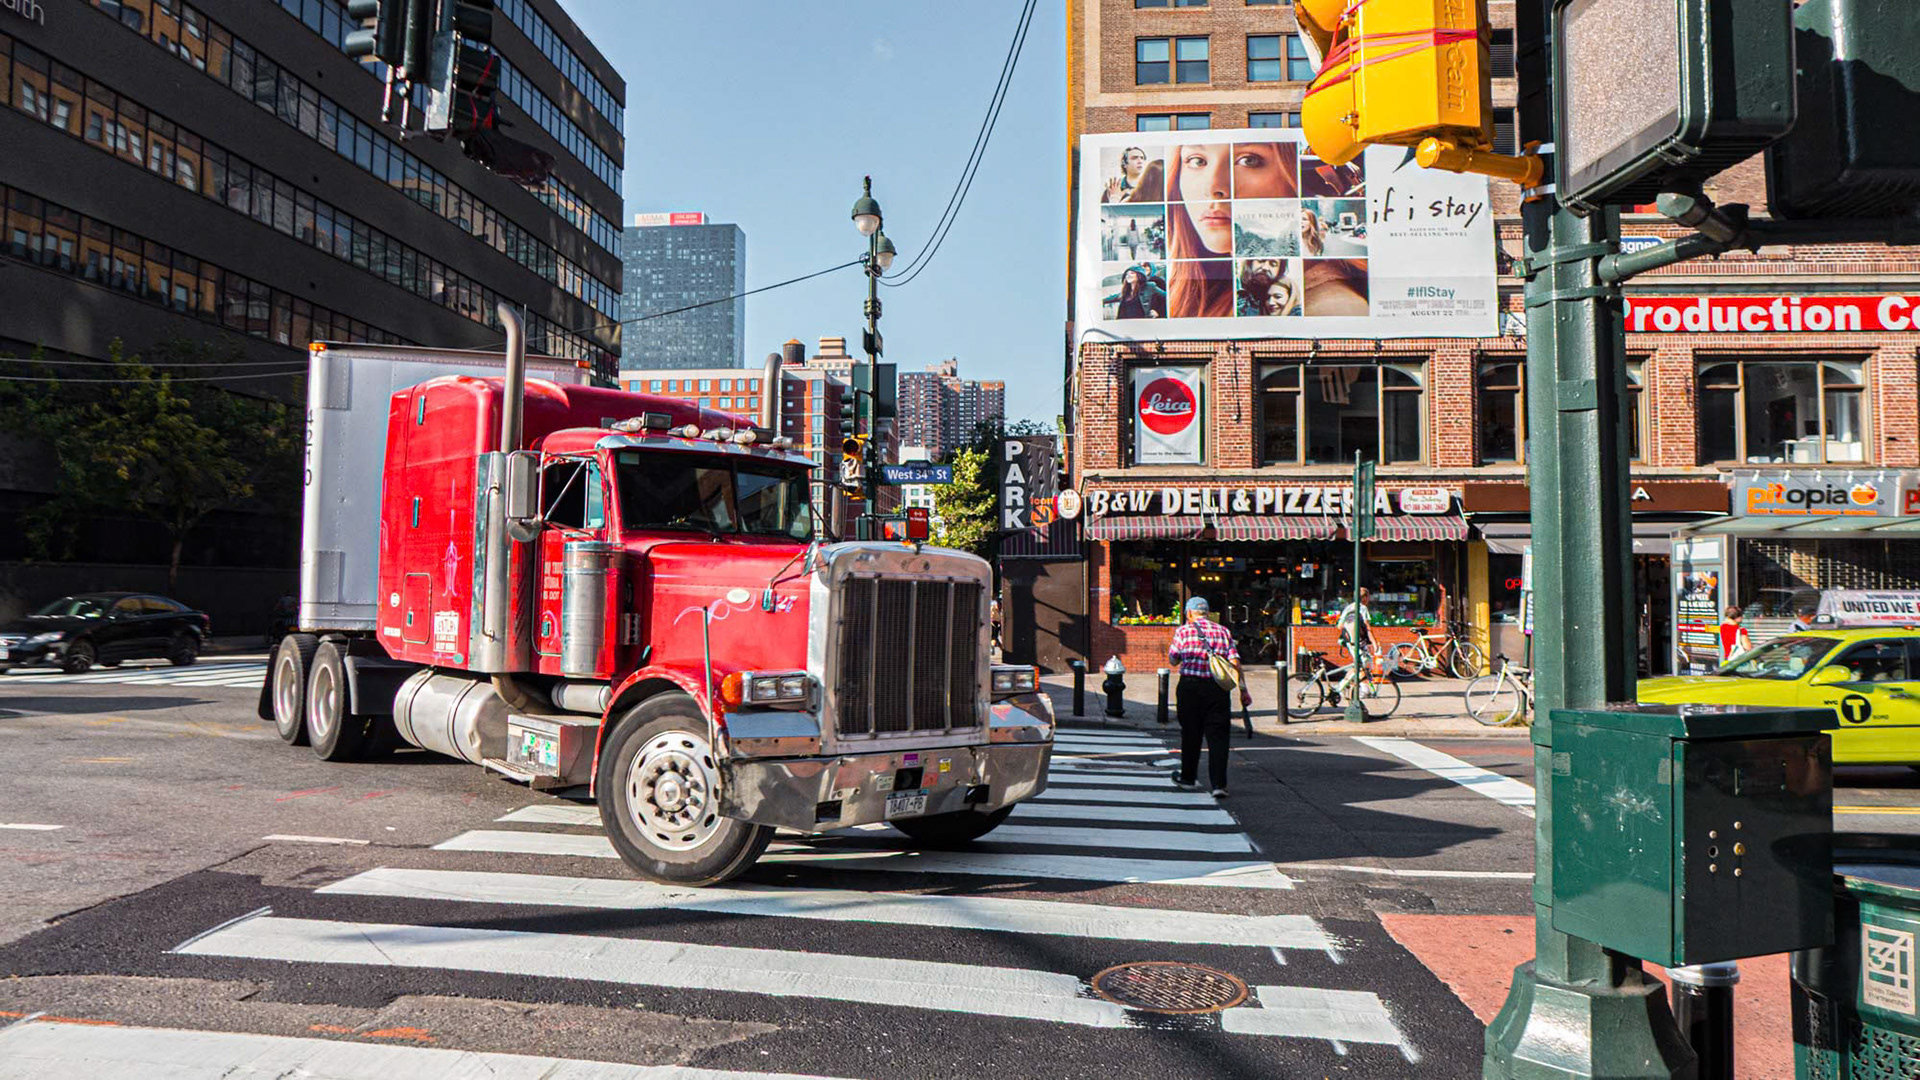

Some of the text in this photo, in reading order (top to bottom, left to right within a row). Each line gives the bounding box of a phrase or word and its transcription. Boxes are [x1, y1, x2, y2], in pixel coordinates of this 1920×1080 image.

[1373, 187, 1482, 228] if i stay
[1141, 393, 1192, 416] Leica
[888, 469, 947, 479] West 34th St
[1005, 441, 1026, 528] PARK
[1091, 490, 1153, 515] B&W
[1256, 487, 1393, 514] PIZZERA
[1747, 482, 1849, 509] pitopia
[1505, 578, 1523, 590] OP
[1843, 601, 1915, 613] UNITED WE
[1845, 699, 1865, 721] T
